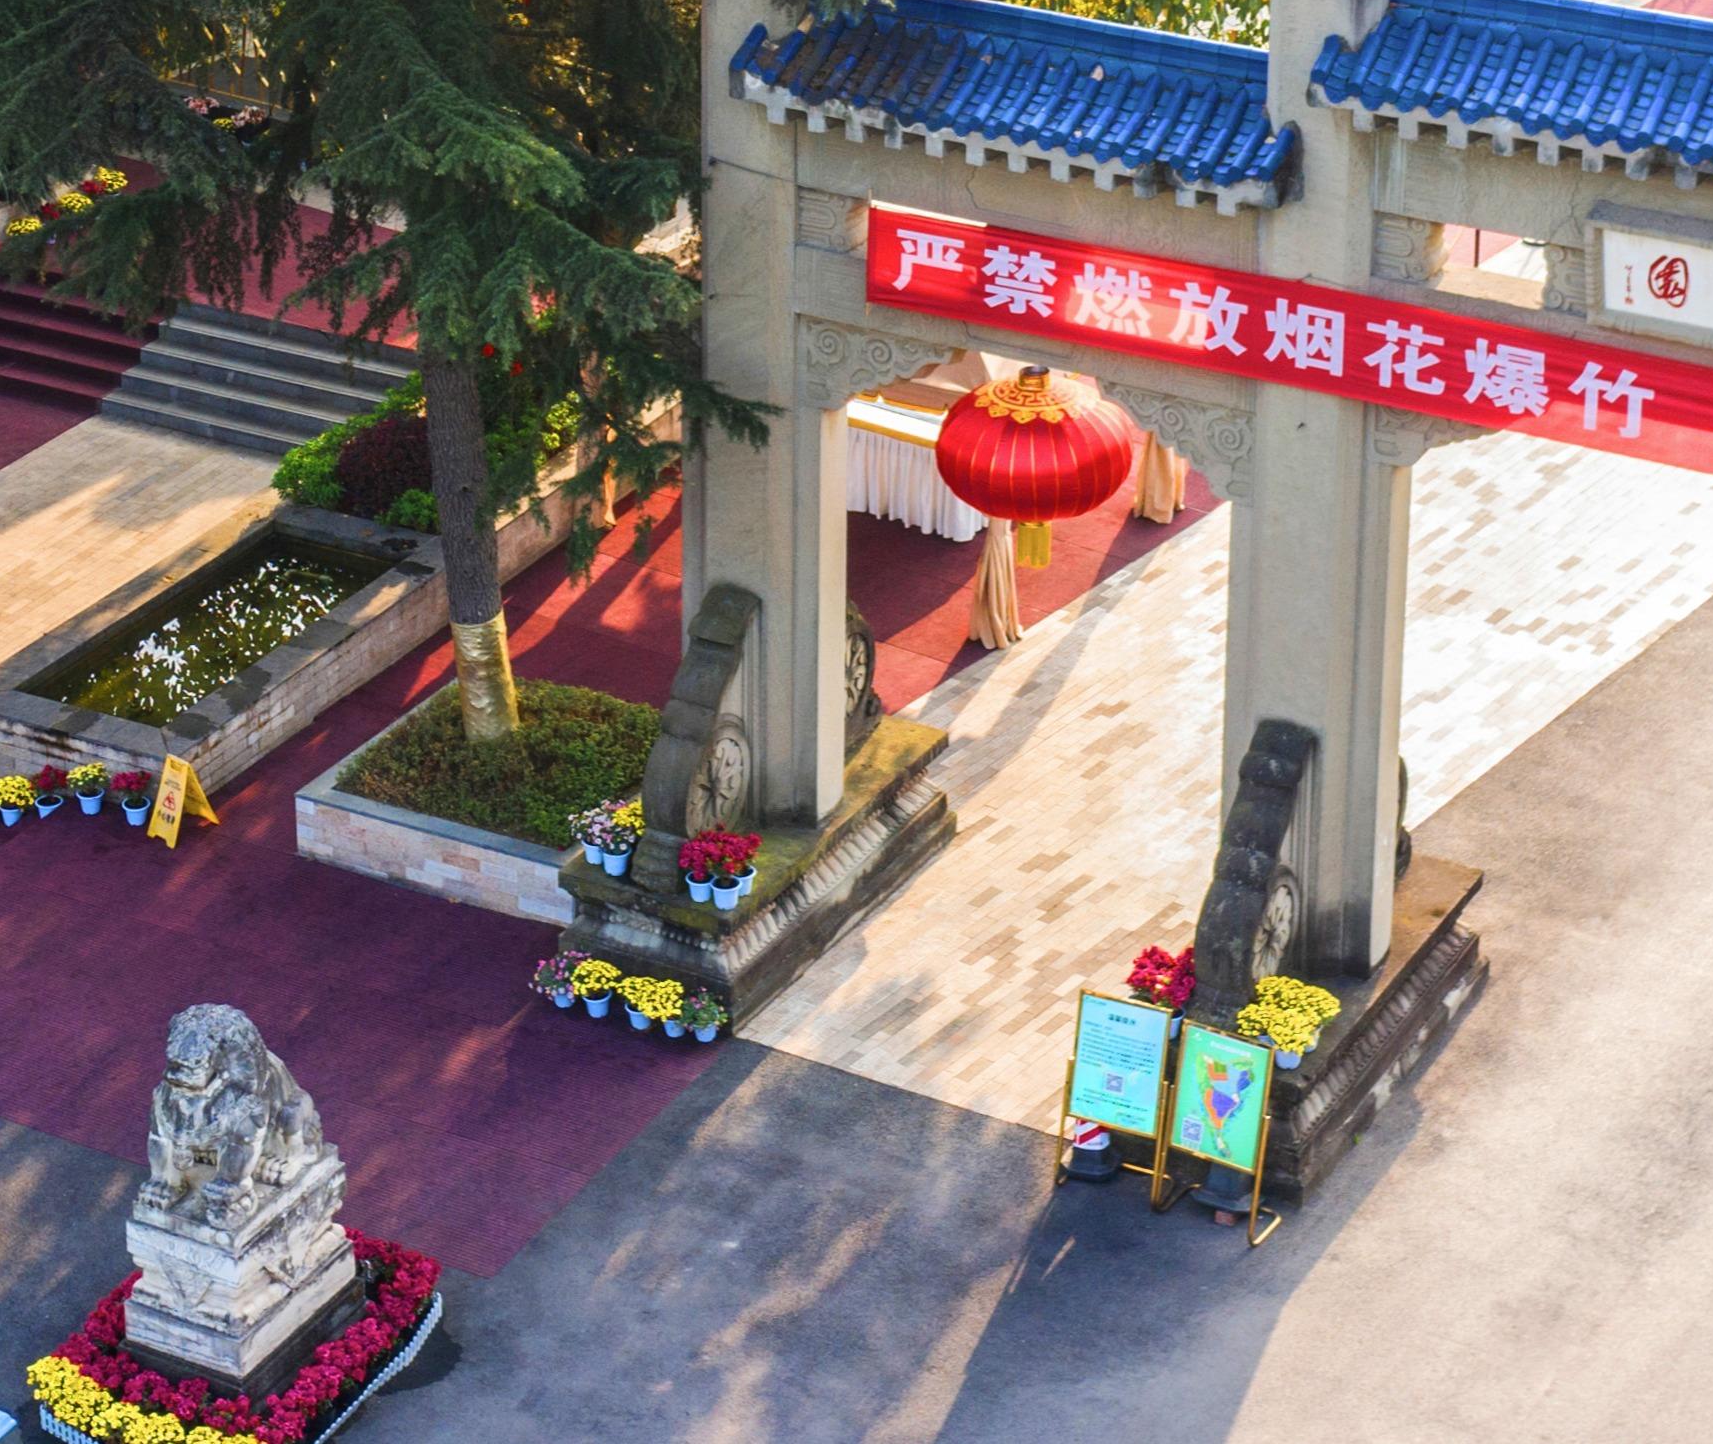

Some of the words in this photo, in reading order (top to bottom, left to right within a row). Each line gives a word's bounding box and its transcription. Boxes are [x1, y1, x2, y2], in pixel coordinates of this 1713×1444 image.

[891, 227, 1655, 442] 严禁燃放烟花爆竹
